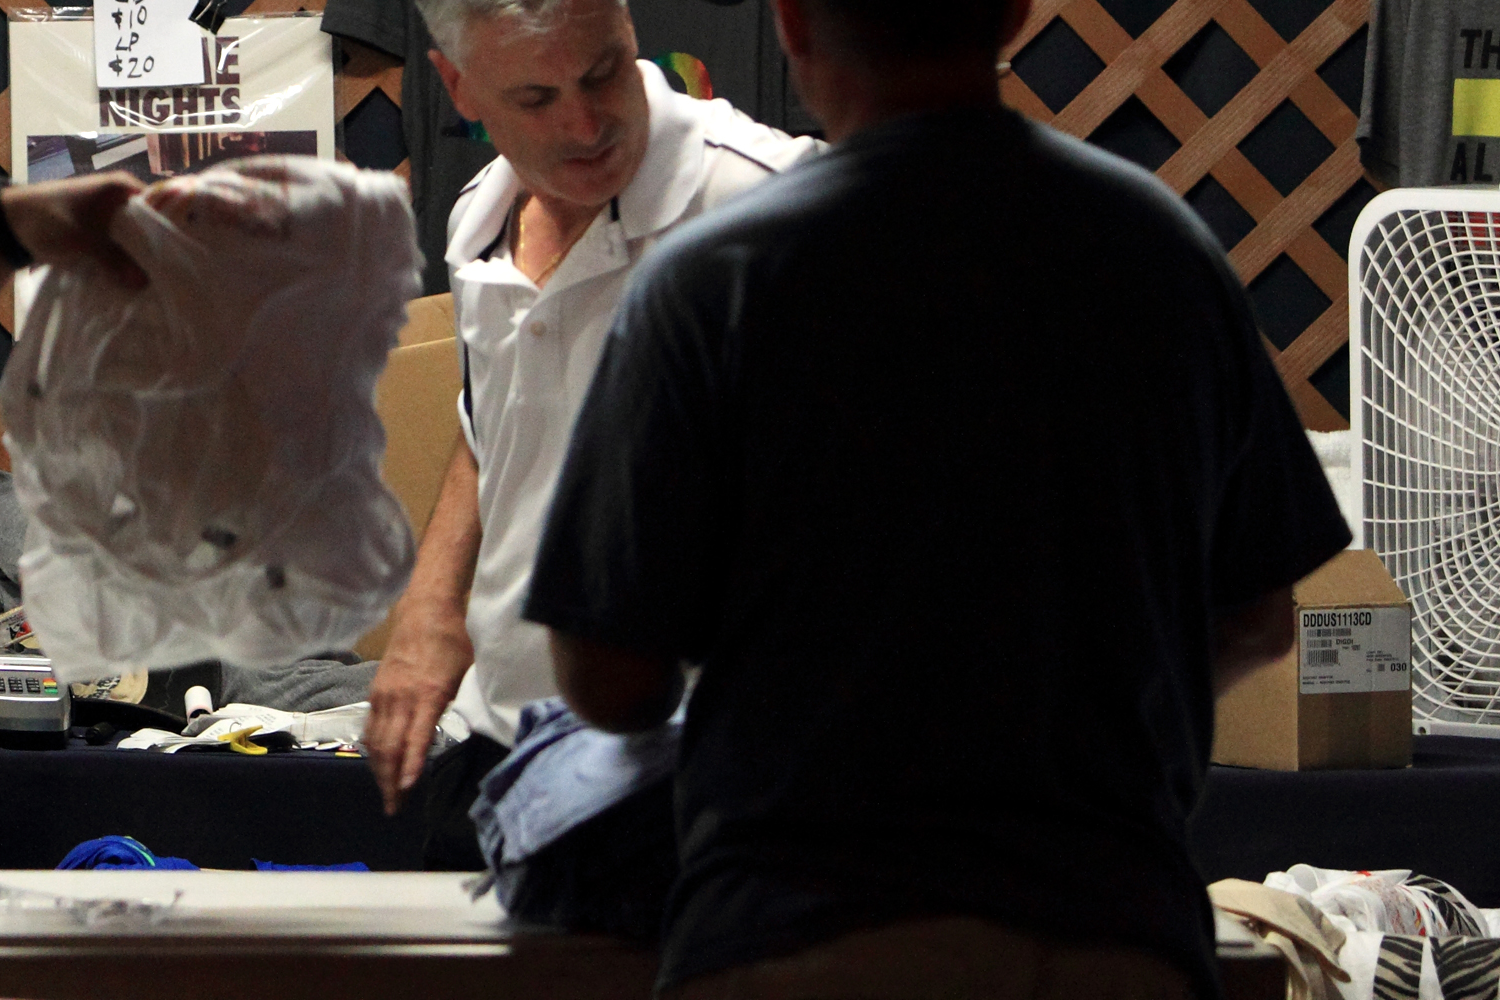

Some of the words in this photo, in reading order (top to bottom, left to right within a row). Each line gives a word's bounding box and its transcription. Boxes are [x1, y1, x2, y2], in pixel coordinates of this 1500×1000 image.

[111, 5, 148, 30] $10
[115, 32, 140, 52] LP
[108, 54, 155, 79] $20
[99, 87, 241, 127] NIGHTS
[1303, 612, 1372, 628] DDDUS1113CD
[1390, 662, 1407, 672] 030
